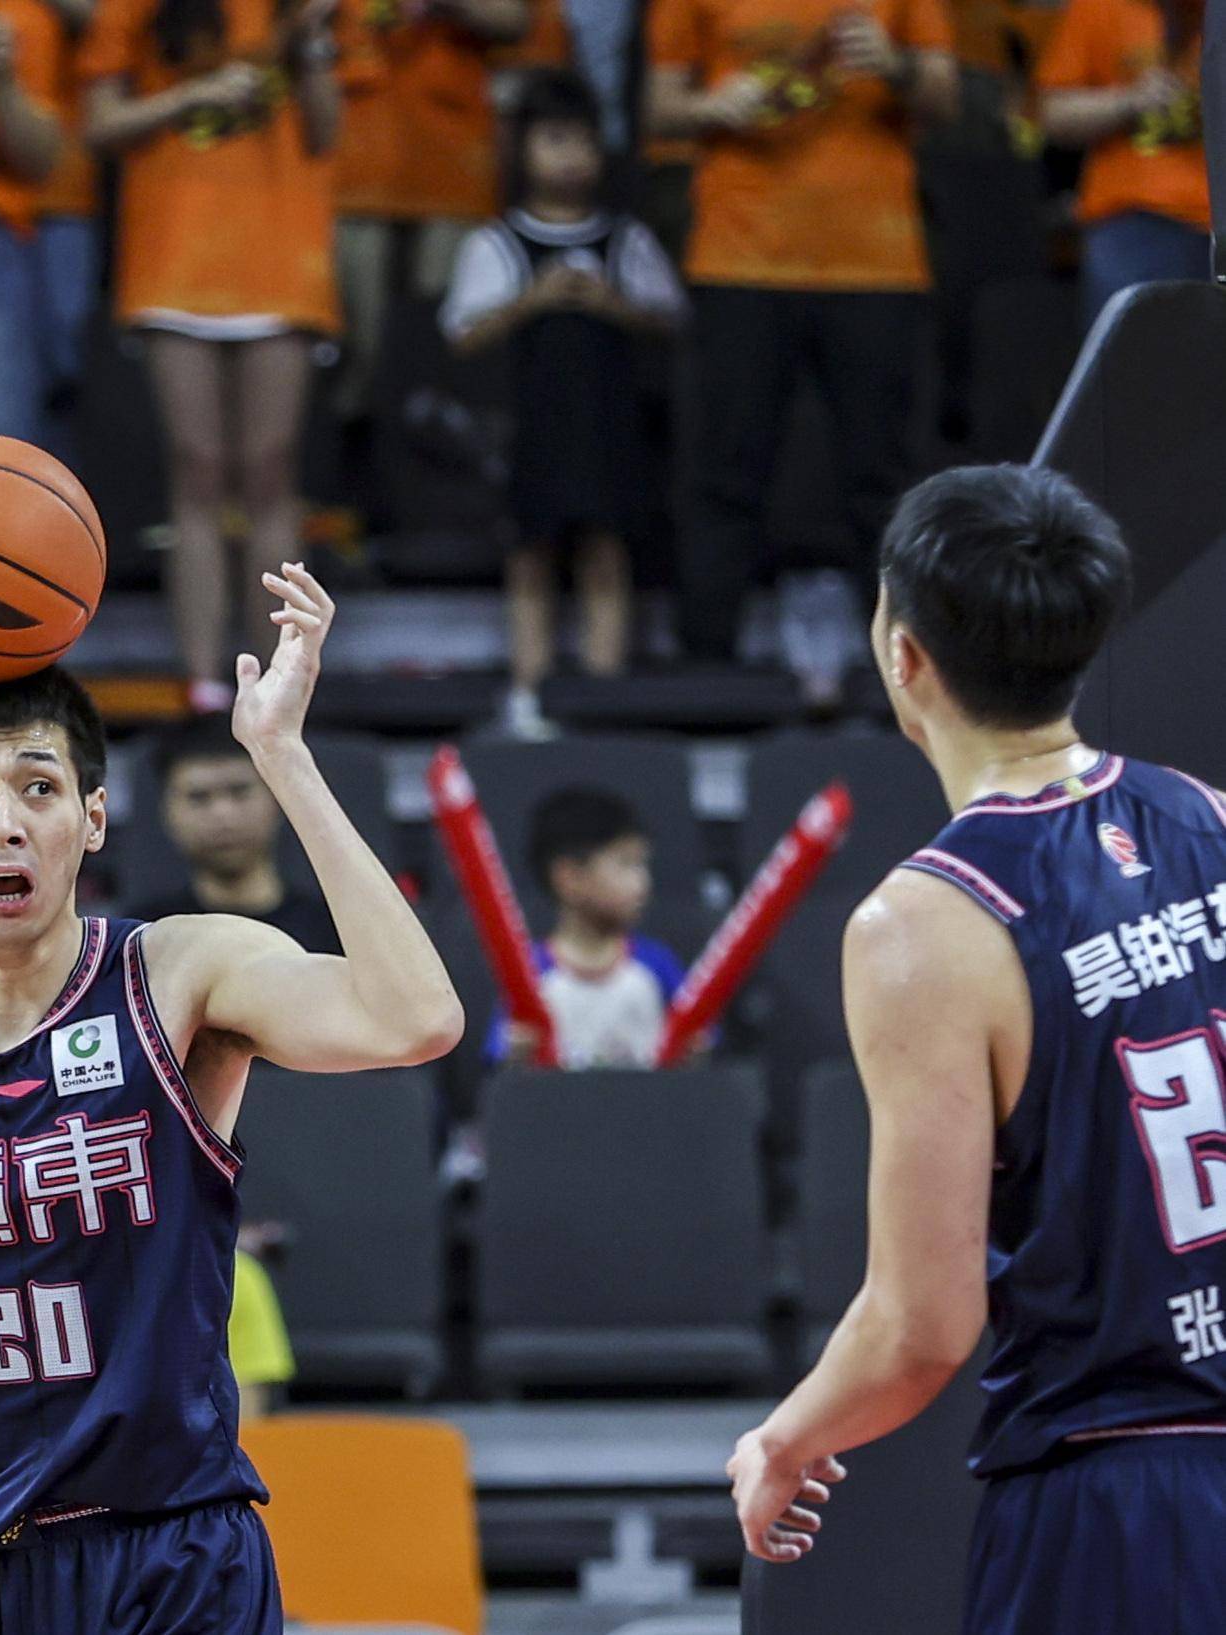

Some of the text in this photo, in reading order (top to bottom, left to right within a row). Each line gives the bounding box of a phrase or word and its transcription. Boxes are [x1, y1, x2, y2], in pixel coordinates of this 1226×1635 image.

[60, 1060, 115, 1079] 中国人寿
[62, 1073, 116, 1088] CHINA LIFE
[1114, 1009, 1226, 1254] 2
[1167, 1285, 1226, 1364] 张
